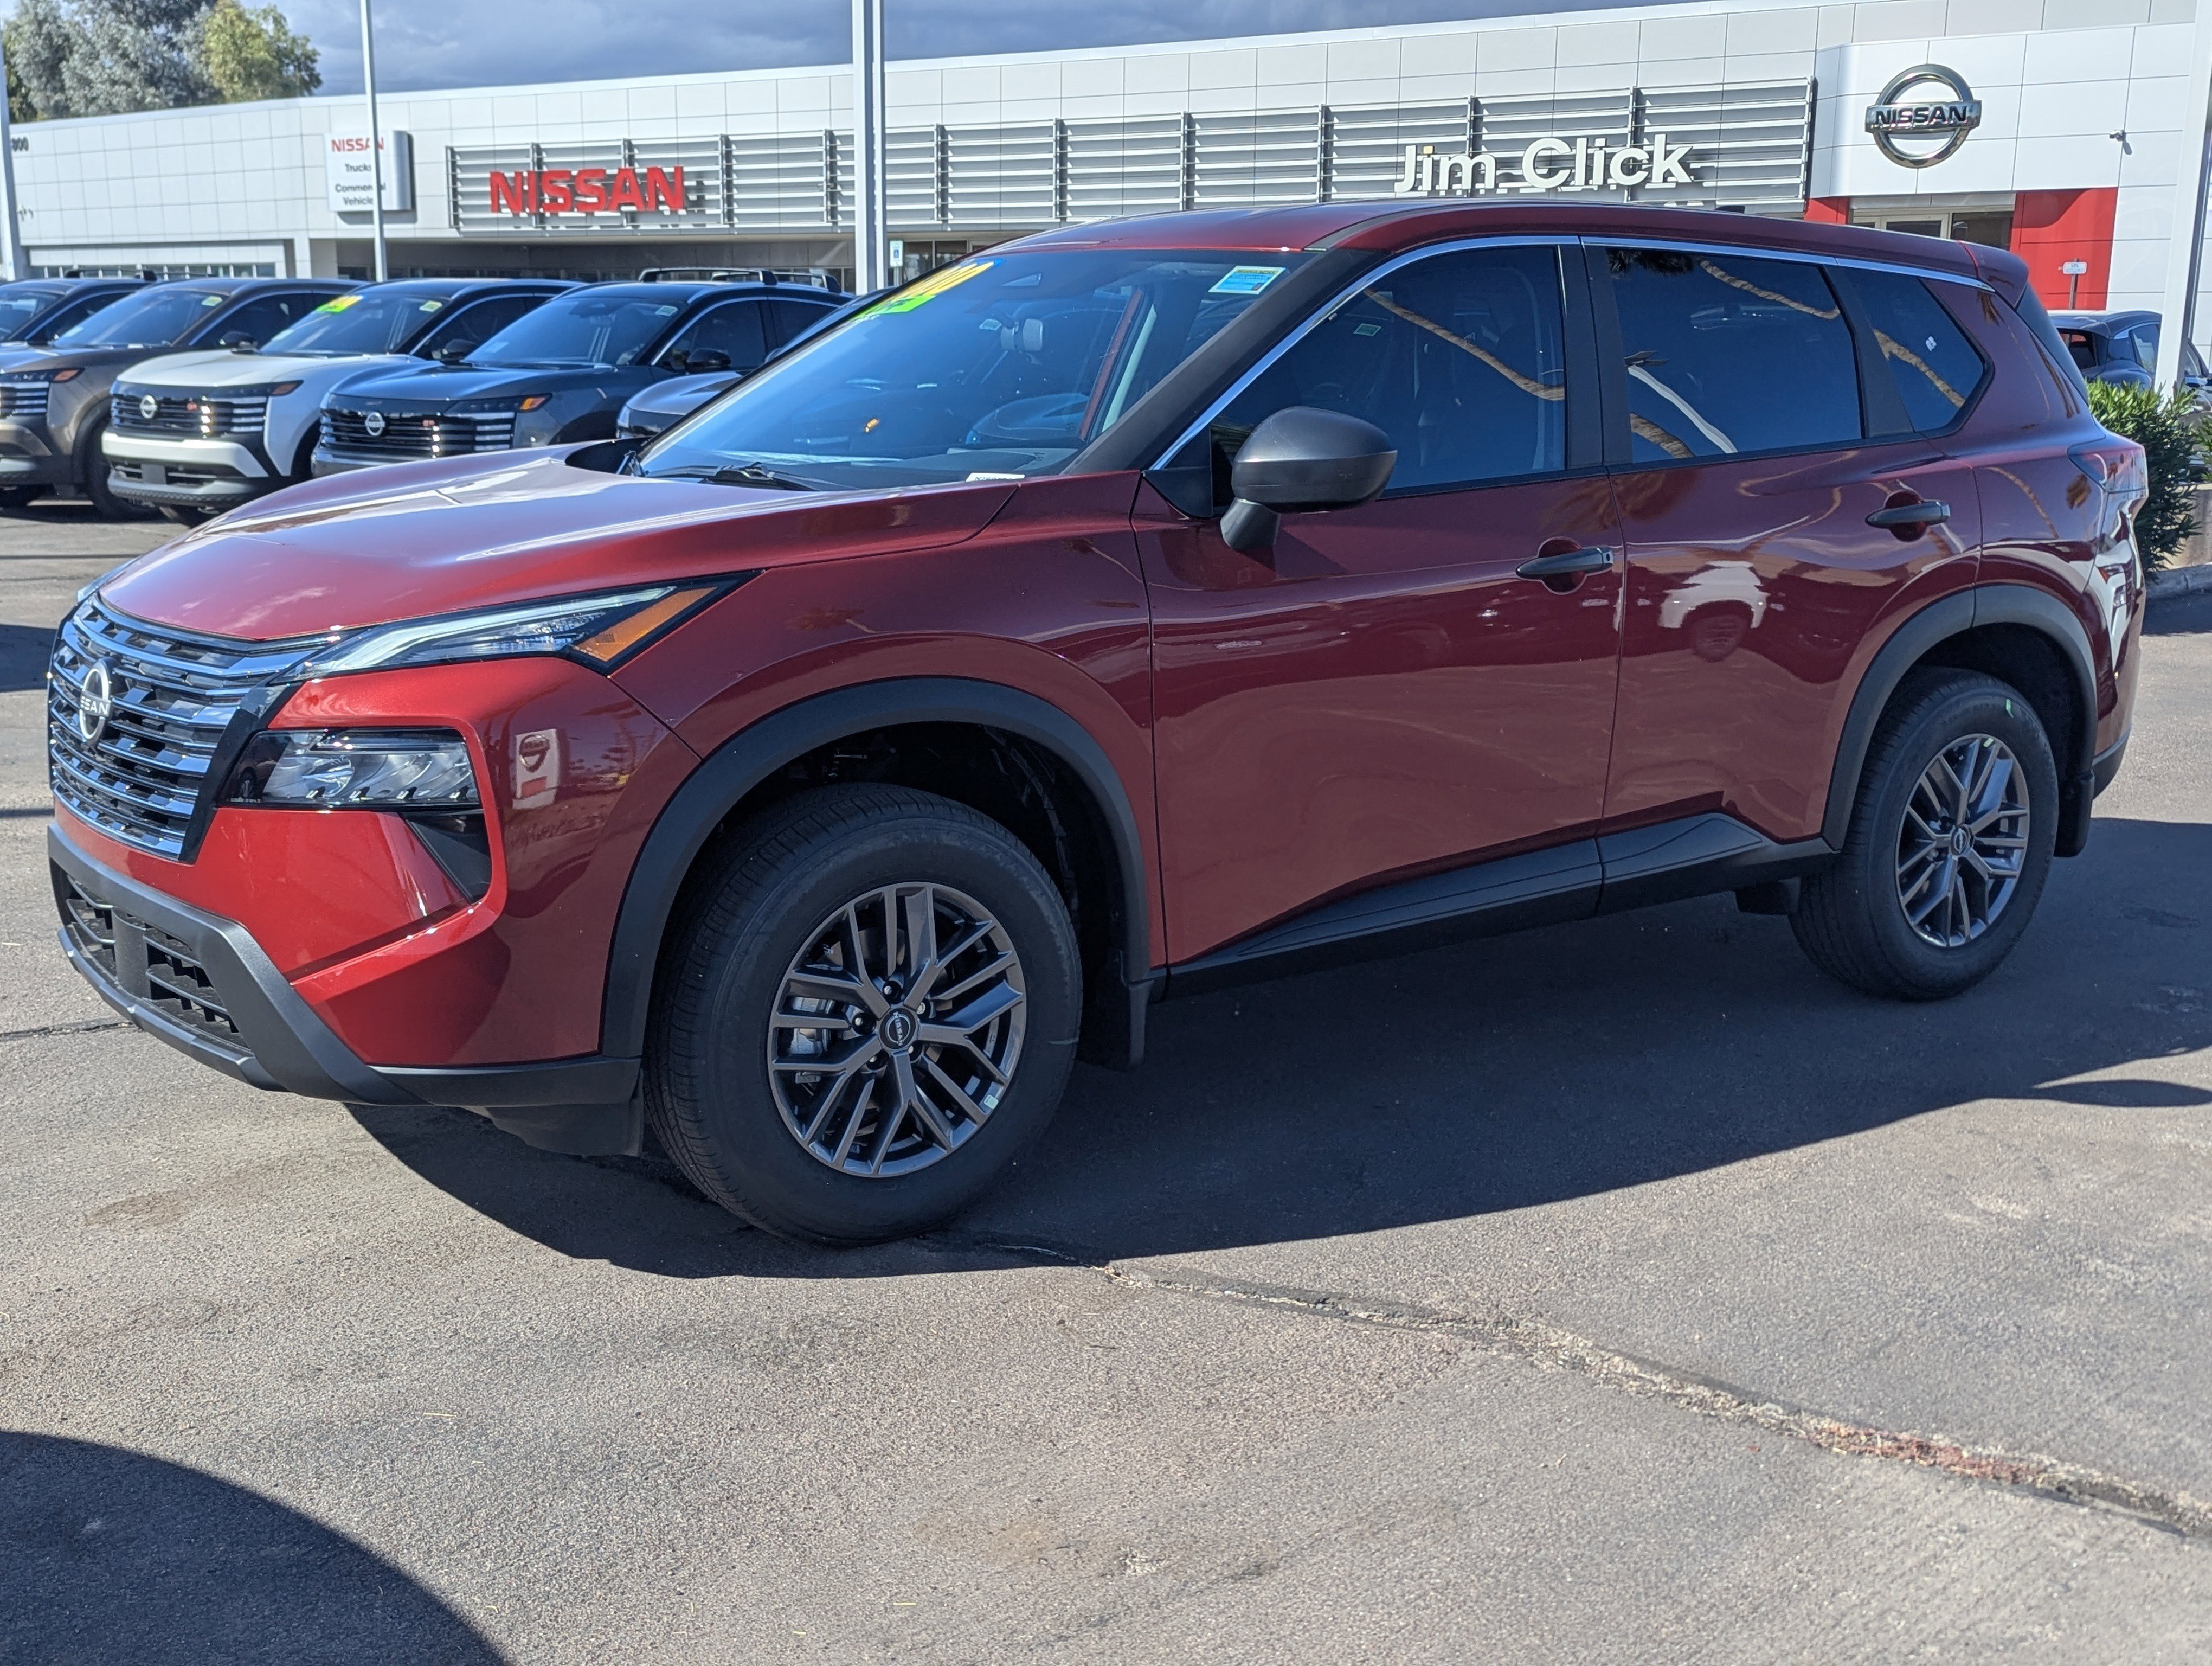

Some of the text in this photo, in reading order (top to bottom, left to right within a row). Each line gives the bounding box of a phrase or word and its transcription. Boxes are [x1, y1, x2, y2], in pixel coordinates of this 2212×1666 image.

[1875, 105, 1968, 126] NISSAN
[1394, 133, 1693, 193] Jim Click
[335, 182, 386, 193] Commeral
[490, 166, 685, 214] NISSAN
[343, 196, 374, 206] Vehicle
